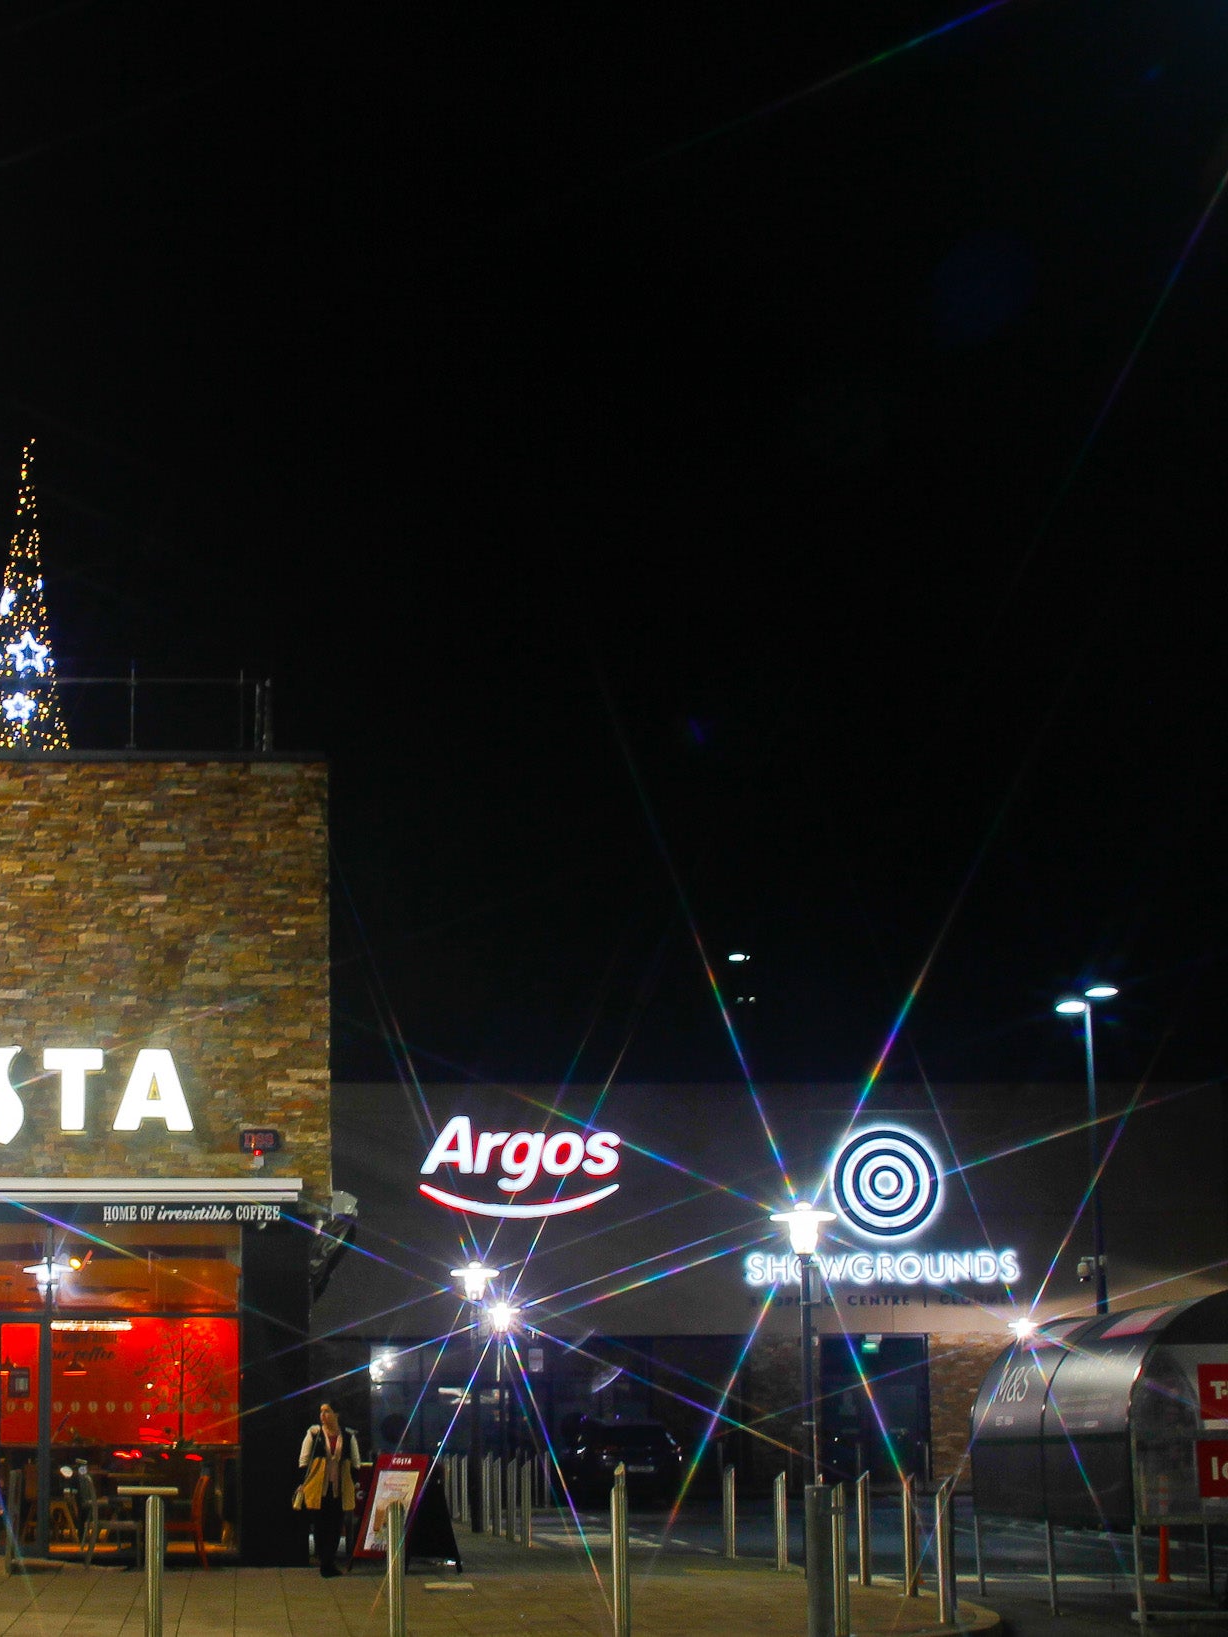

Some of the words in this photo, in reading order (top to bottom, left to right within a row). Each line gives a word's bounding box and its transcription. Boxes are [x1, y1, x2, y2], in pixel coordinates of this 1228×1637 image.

[420, 1115, 621, 1192] Argos
[103, 1205, 137, 1222] HOME
[140, 1205, 156, 1221] OF
[157, 1204, 233, 1222] irresistible
[236, 1204, 281, 1222] COFFEE
[847, 1295, 910, 1307] CENTRE
[993, 1365, 1036, 1403] M&S
[392, 1457, 412, 1466] COSTA
